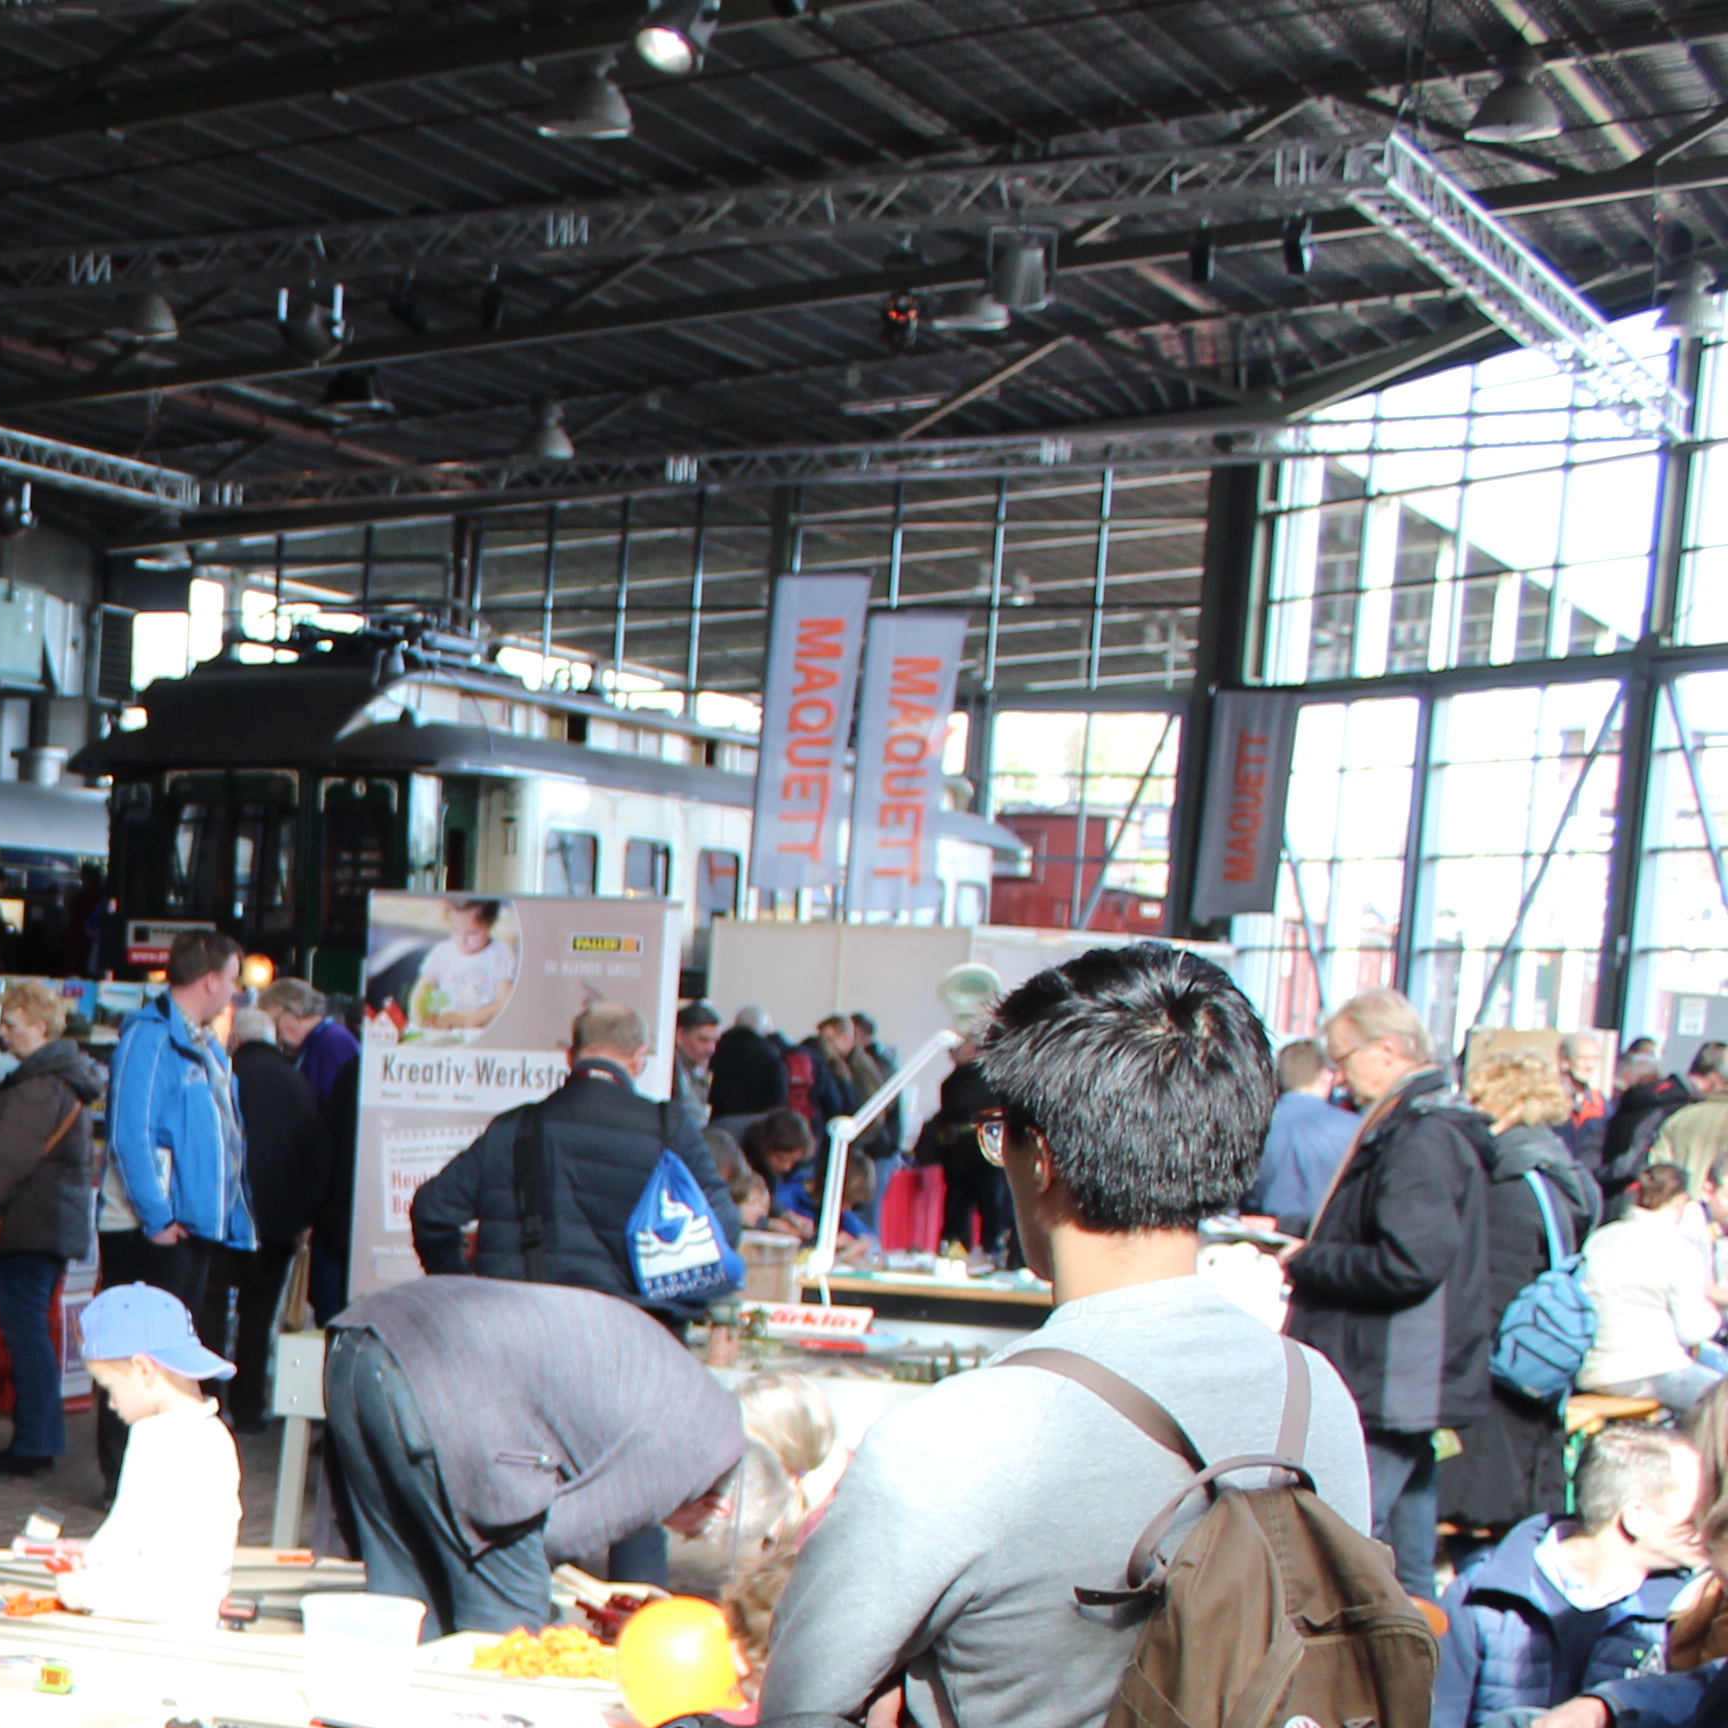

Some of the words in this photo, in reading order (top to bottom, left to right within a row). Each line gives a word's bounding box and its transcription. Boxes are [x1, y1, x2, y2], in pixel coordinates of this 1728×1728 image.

[776, 617, 846, 862] MAQUETT
[872, 656, 942, 887] MAQUETT
[1222, 729, 1270, 883] MAQUETT
[574, 936, 621, 951] FALLER
[382, 1057, 571, 1088] Kreativ-Werksta
[768, 1308, 859, 1330] ärklin
